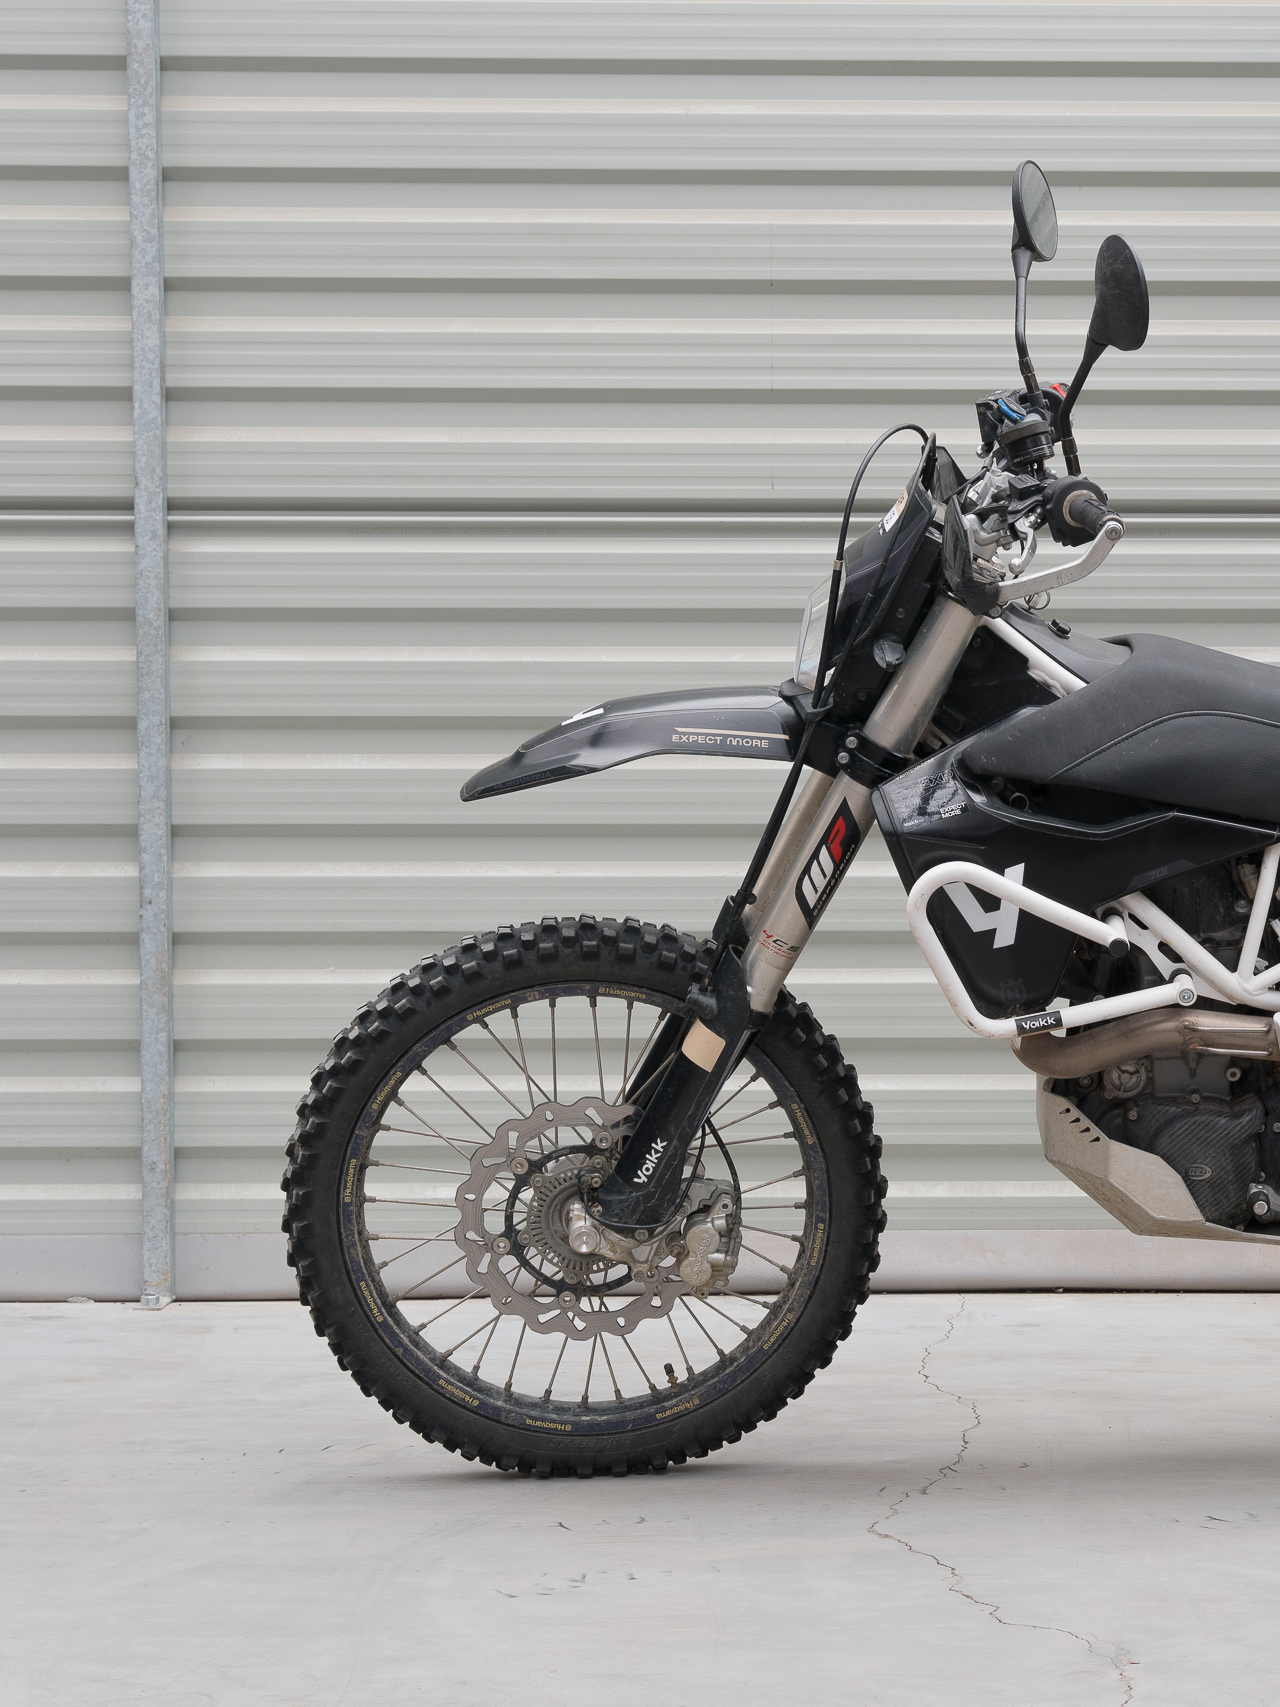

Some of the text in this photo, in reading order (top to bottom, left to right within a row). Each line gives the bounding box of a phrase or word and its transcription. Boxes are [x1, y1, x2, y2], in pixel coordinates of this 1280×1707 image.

[672, 734, 770, 748] EXPECT MORE
[940, 802, 966, 814] EXPECT
[941, 809, 962, 819] MORE
[801, 815, 847, 910] WP
[762, 929, 801, 953] 4CS
[605, 987, 646, 1000] Husqvarna
[470, 998, 512, 1019] Husqvarna
[374, 1071, 402, 1104] Husqvarna
[794, 1109, 814, 1145] Husqvarna
[346, 1158, 357, 1196] Husqvarna
[812, 1227, 824, 1266] Husqvarna
[359, 1281, 381, 1318] Husqvarna
[762, 1318, 790, 1350] Husqvarna
[438, 1379, 474, 1404] Husqvarna
[525, 1418, 565, 1431] Husqvarna
